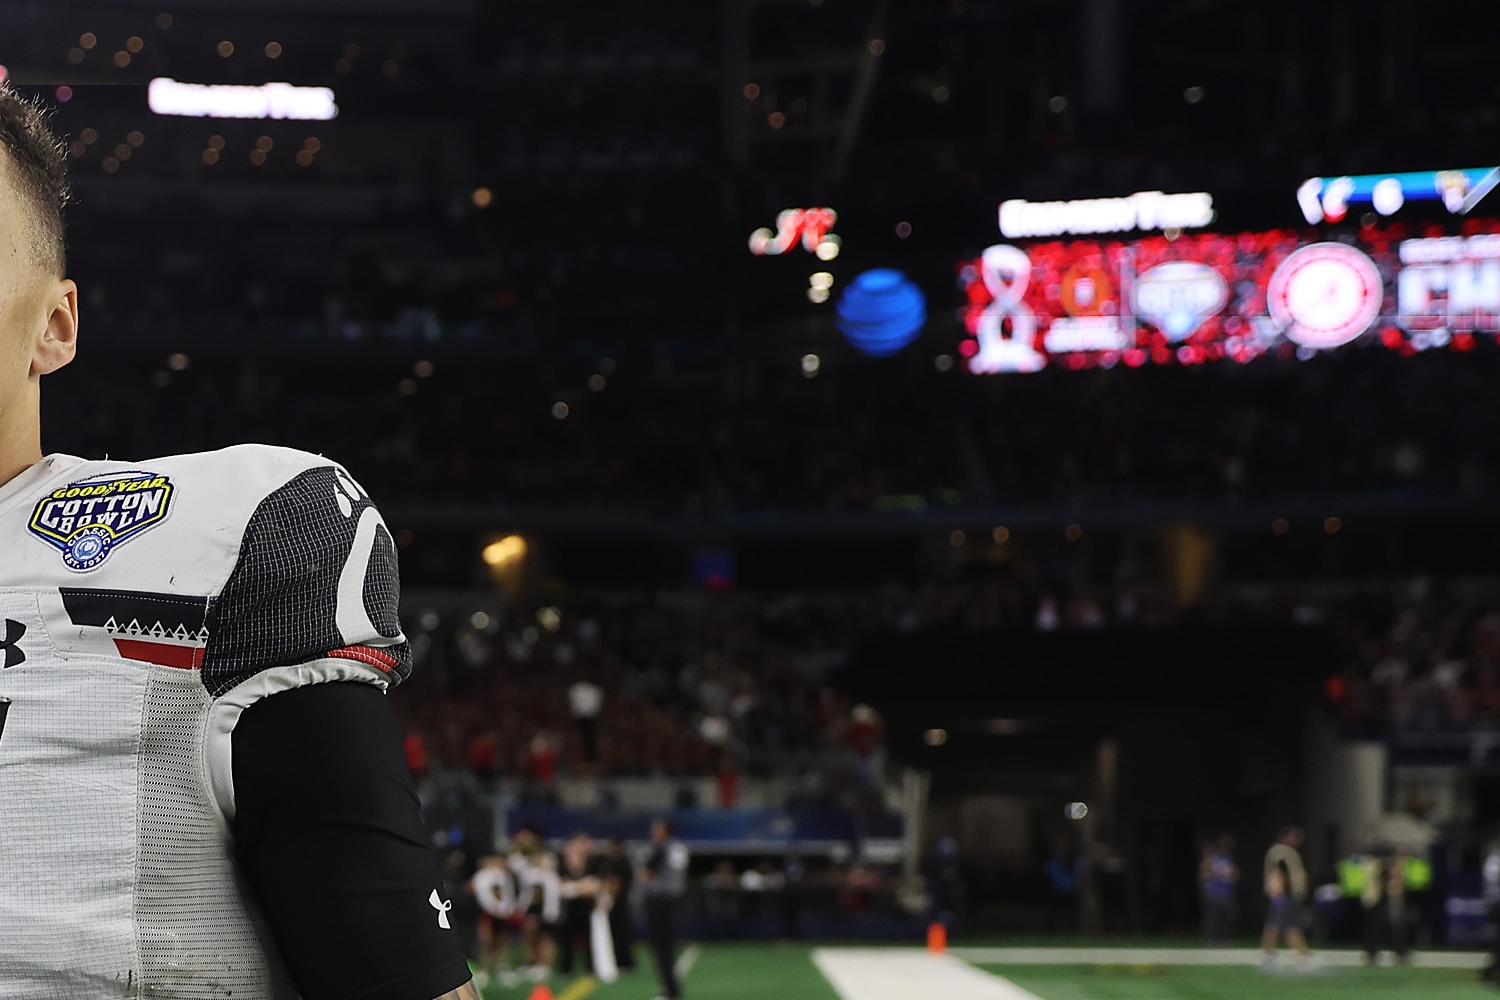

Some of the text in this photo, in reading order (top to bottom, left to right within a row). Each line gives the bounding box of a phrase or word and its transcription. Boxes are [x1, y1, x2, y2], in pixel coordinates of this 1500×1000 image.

[52, 477, 167, 499] GOODYEAR
[40, 488, 164, 529] COTTON
[57, 511, 134, 535] BOWL
[67, 527, 112, 547] CLASSIC
